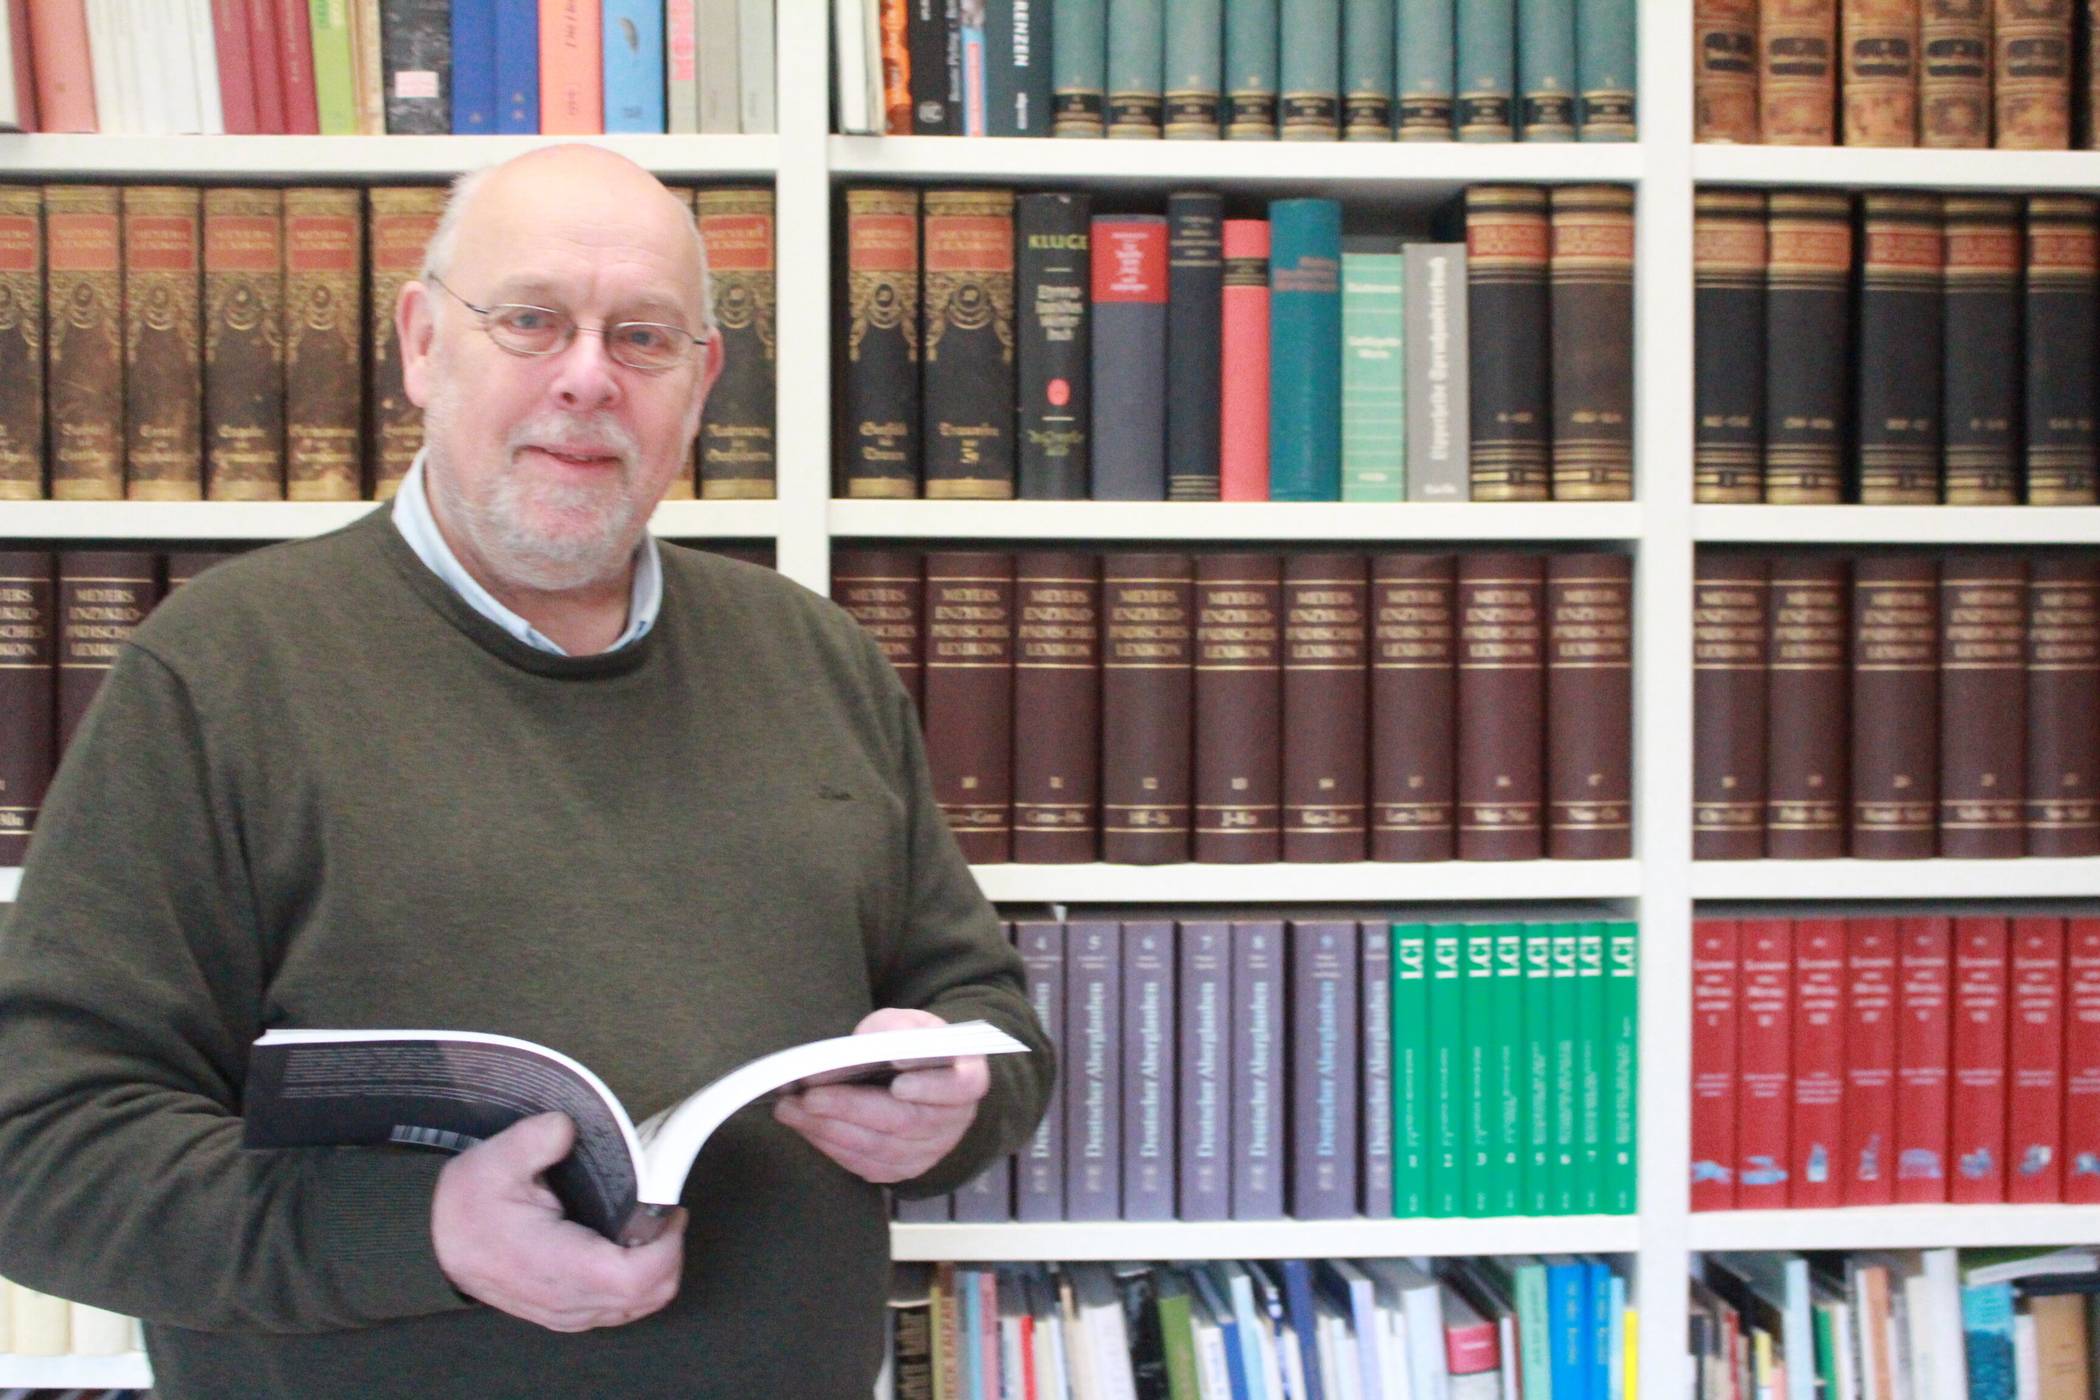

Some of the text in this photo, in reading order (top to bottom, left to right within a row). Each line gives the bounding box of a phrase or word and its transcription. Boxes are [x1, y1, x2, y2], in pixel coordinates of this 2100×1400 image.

[1028, 234, 1088, 250] KLUGE
[1088, 934, 1102, 951] 5
[1201, 935, 1214, 950] 7
